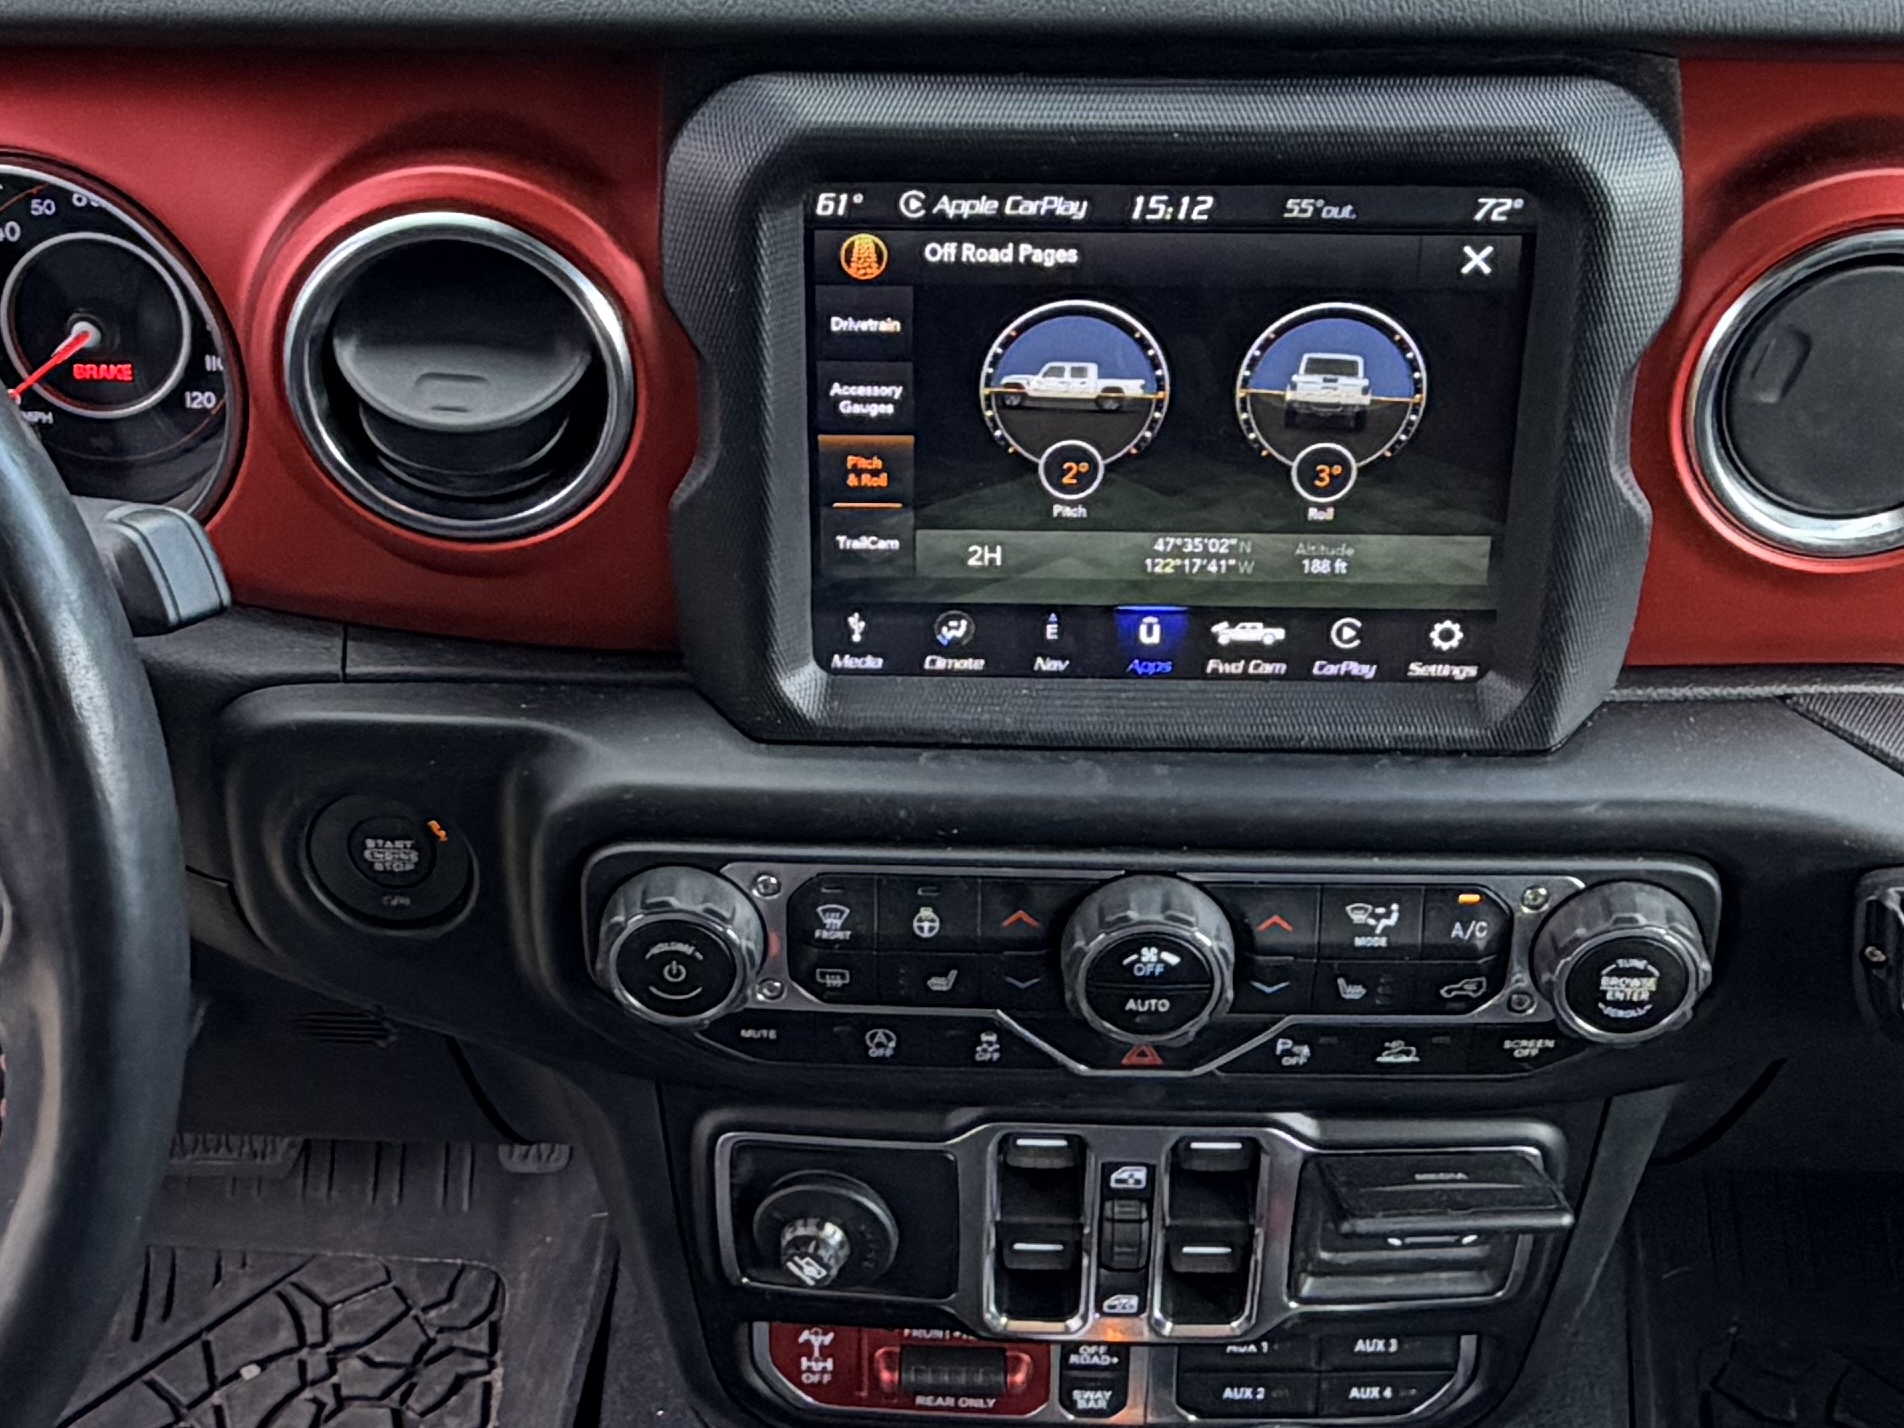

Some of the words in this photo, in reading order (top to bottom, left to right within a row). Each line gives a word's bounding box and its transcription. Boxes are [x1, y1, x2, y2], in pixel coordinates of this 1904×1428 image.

[30, 198, 56, 217] 50
[815, 192, 864, 216] 61°
[932, 196, 998, 220] Apple
[1004, 195, 1088, 220] CarPlay
[1131, 195, 1214, 220] 15:12
[1472, 198, 1524, 222] 72°
[924, 242, 958, 262] Off
[961, 243, 1014, 262] Road
[1018, 243, 1078, 266] Pages
[830, 316, 901, 333] Drivetrain
[72, 363, 133, 383] BRAKE
[829, 382, 903, 399] Accessory
[184, 390, 216, 409] 120
[838, 400, 895, 415] Gauges
[847, 455, 883, 470] Pitch
[862, 472, 889, 488] Roll
[1052, 503, 1087, 519] Pitch
[1307, 506, 1334, 521] Roll
[836, 535, 899, 551] TrailCam
[1295, 542, 1356, 557] Altitude
[967, 545, 1002, 567] 2H
[1302, 558, 1331, 574] 188
[1334, 558, 1348, 574] ft
[830, 654, 884, 670] Media
[923, 655, 986, 671] Climate
[1033, 657, 1070, 671] Nav
[1126, 659, 1173, 675] Apps
[1205, 659, 1245, 674] Fwd
[1249, 659, 1287, 675] Cam
[1312, 660, 1377, 679] CarPlay
[1406, 662, 1478, 679] Settings
[814, 929, 852, 940] FRONT
[1450, 921, 1489, 940] A/C
[1354, 936, 1388, 948] MODE
[1133, 963, 1165, 977] OFF
[1124, 998, 1171, 1012] AUTO
[740, 1029, 777, 1039] MUTE
[1503, 1038, 1555, 1050] SCREEN
[868, 1048, 894, 1058] OFF
[974, 1051, 1000, 1062] OFF
[1513, 1047, 1539, 1058] OFF
[1354, 1338, 1387, 1352] AUX
[1389, 1339, 1398, 1352] 3
[802, 1373, 831, 1385] OFF
[1223, 1387, 1255, 1400] AUX
[1256, 1387, 1265, 1400] 2
[1349, 1386, 1382, 1399] AUX
[1383, 1386, 1393, 1399] 4
[915, 1395, 954, 1408] REAR
[957, 1397, 996, 1409] ONLY
[1077, 1398, 1108, 1410] BAR
